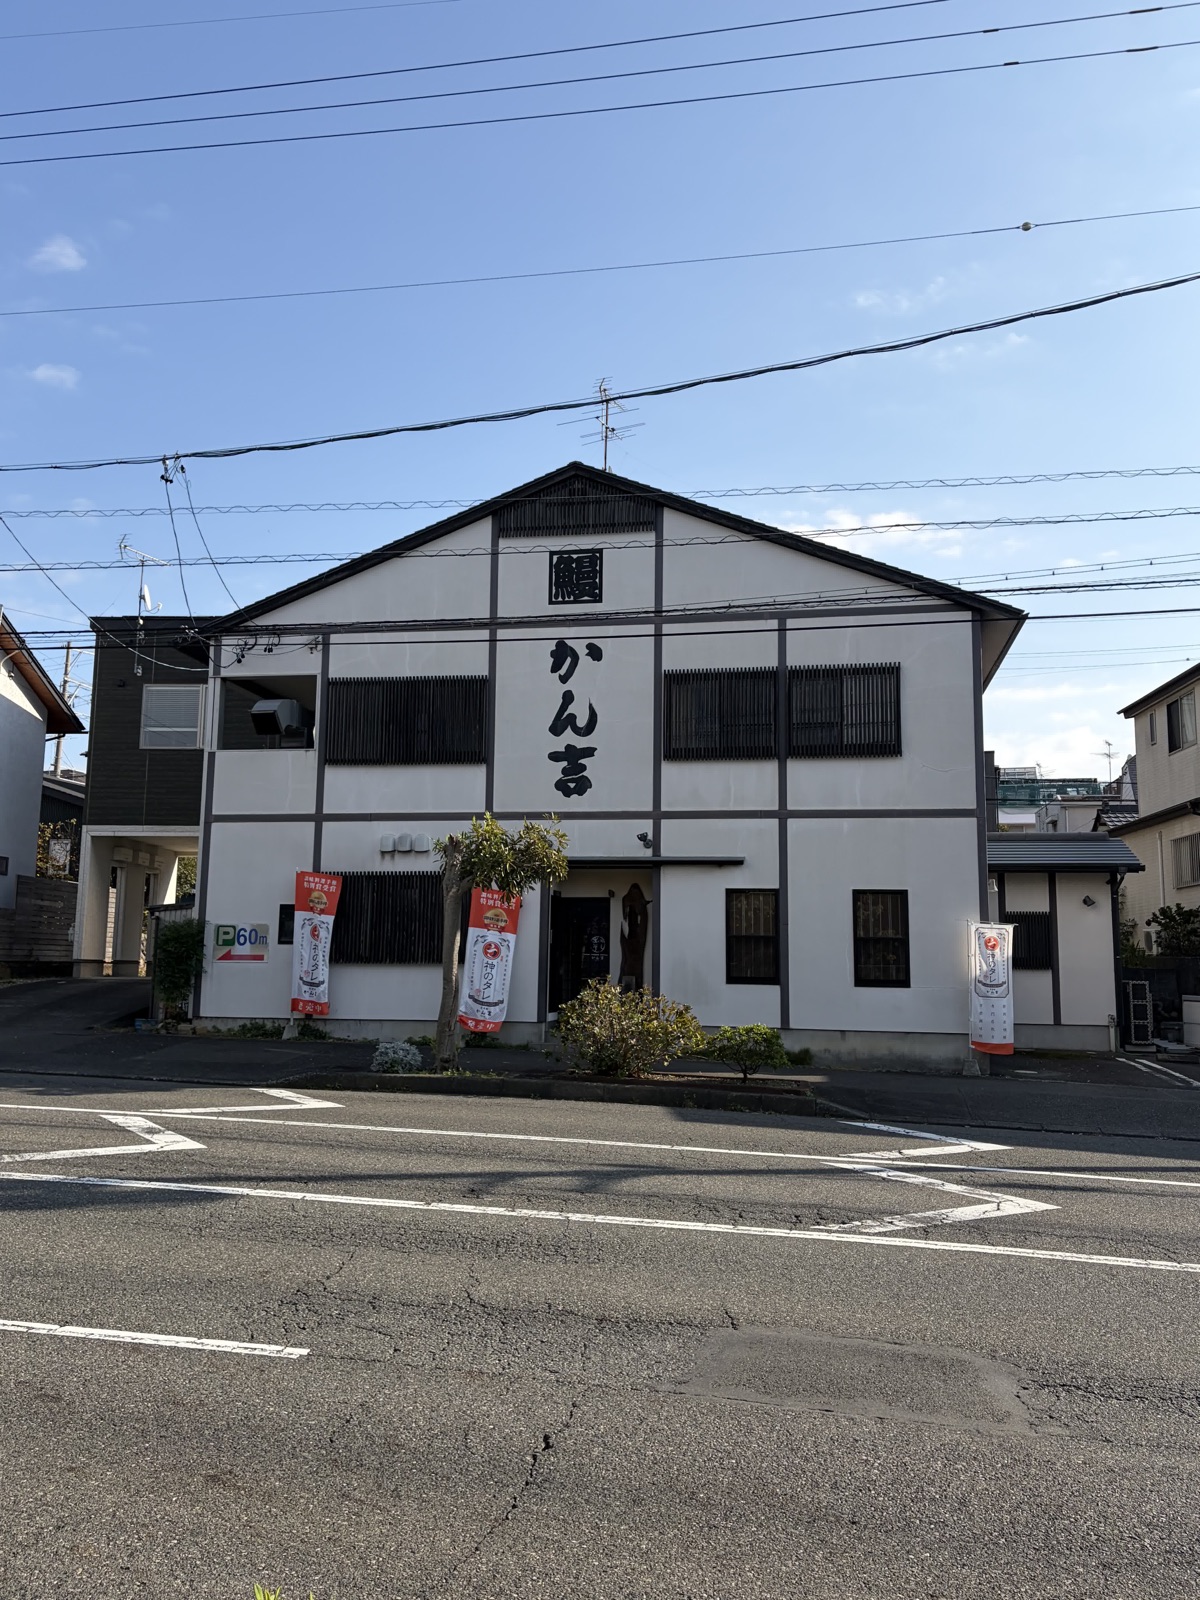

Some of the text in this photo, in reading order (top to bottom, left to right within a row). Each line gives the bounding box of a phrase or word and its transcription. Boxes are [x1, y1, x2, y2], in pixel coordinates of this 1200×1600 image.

[553, 553, 600, 601] 鰻
[547, 640, 603, 798] かん吉
[218, 926, 268, 946] P 60m
[481, 961, 496, 1000] 神のタレ
